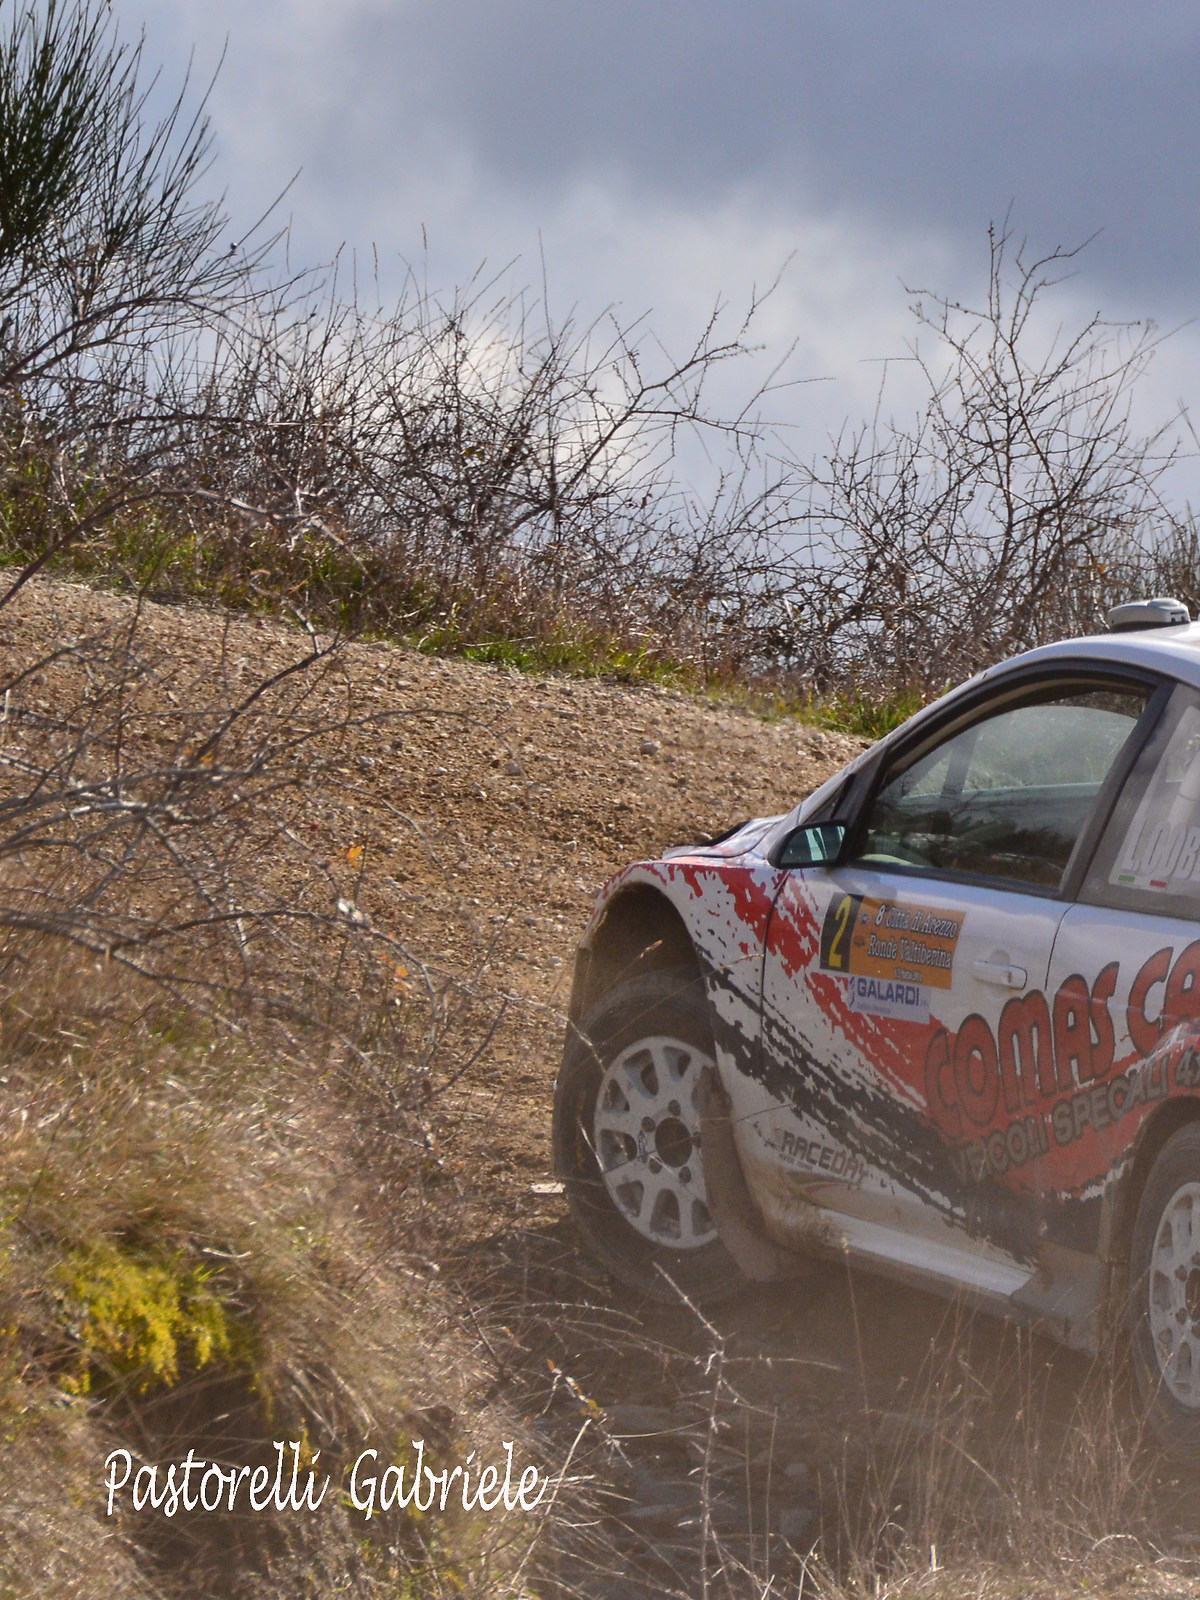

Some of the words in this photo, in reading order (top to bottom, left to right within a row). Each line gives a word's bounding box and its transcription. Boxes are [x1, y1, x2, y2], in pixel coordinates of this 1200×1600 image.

[828, 895, 852, 967] 2
[921, 913, 958, 939] Arezzo
[867, 933, 898, 960] Ronde
[900, 936, 953, 970] Valtiberina
[857, 977, 920, 1006] GALARDI
[924, 961, 1120, 1141] COMAS
